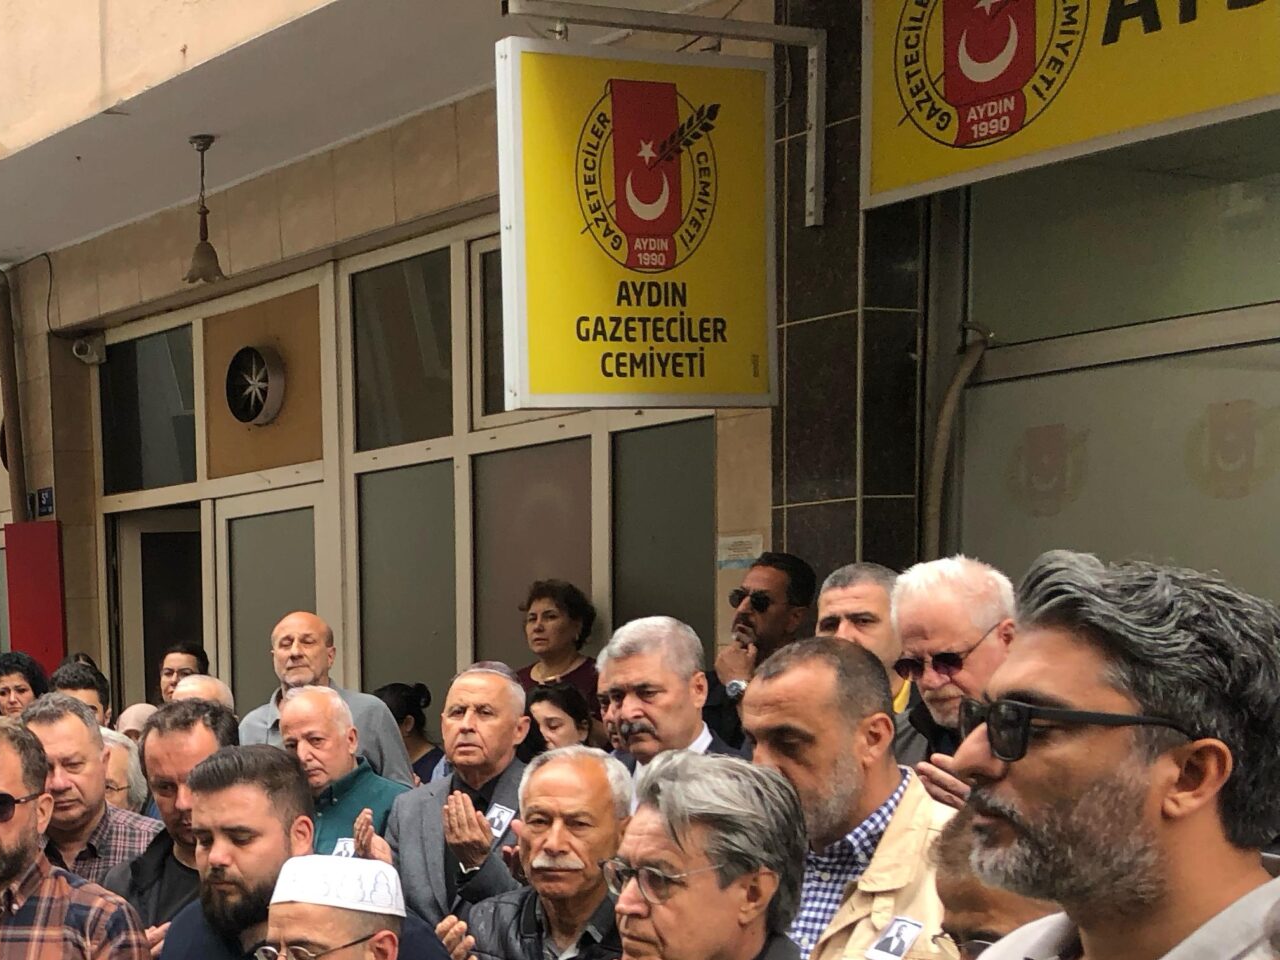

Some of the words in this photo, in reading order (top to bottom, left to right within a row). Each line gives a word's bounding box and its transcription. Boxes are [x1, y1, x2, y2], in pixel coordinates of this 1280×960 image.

[1031, 0, 1080, 101] MİYETİ
[966, 96, 1015, 123] AYDIN
[970, 118, 1010, 139] 1990
[579, 111, 623, 250] GAZETECİLER
[634, 237, 669, 251] AYDIN
[637, 252, 666, 267] 1990
[616, 281, 687, 307] AYDIN
[576, 312, 728, 343] GAZETECİLER
[601, 347, 705, 378] CEMİYETİ
